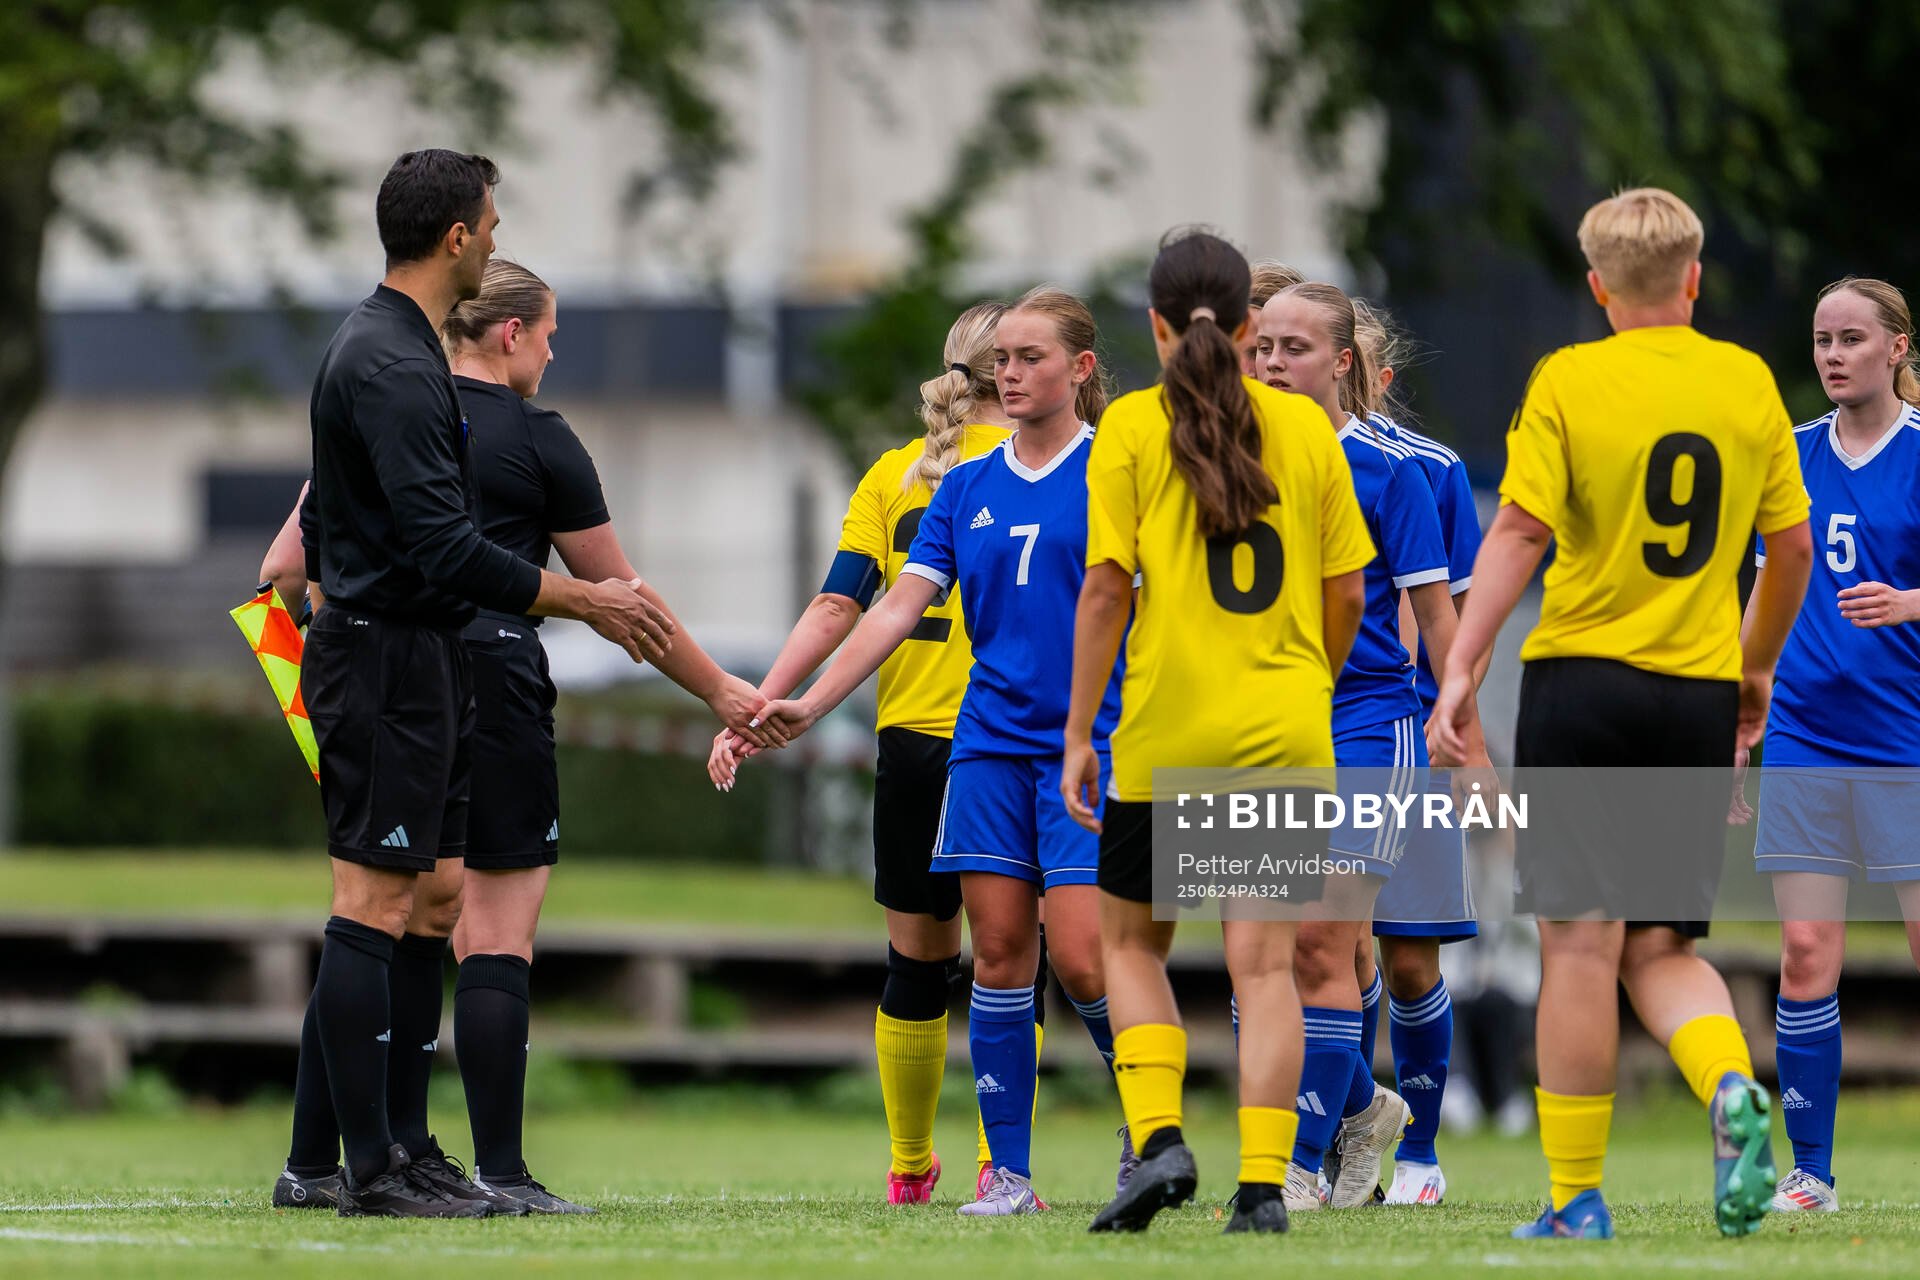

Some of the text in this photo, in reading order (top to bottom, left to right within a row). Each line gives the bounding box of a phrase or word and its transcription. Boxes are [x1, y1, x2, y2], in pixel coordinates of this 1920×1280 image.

[970, 518, 994, 530] adidas
[1642, 431, 1722, 579] 9
[1009, 523, 1040, 586] 7
[1205, 500, 1285, 616] 6
[1826, 513, 1857, 573] 5
